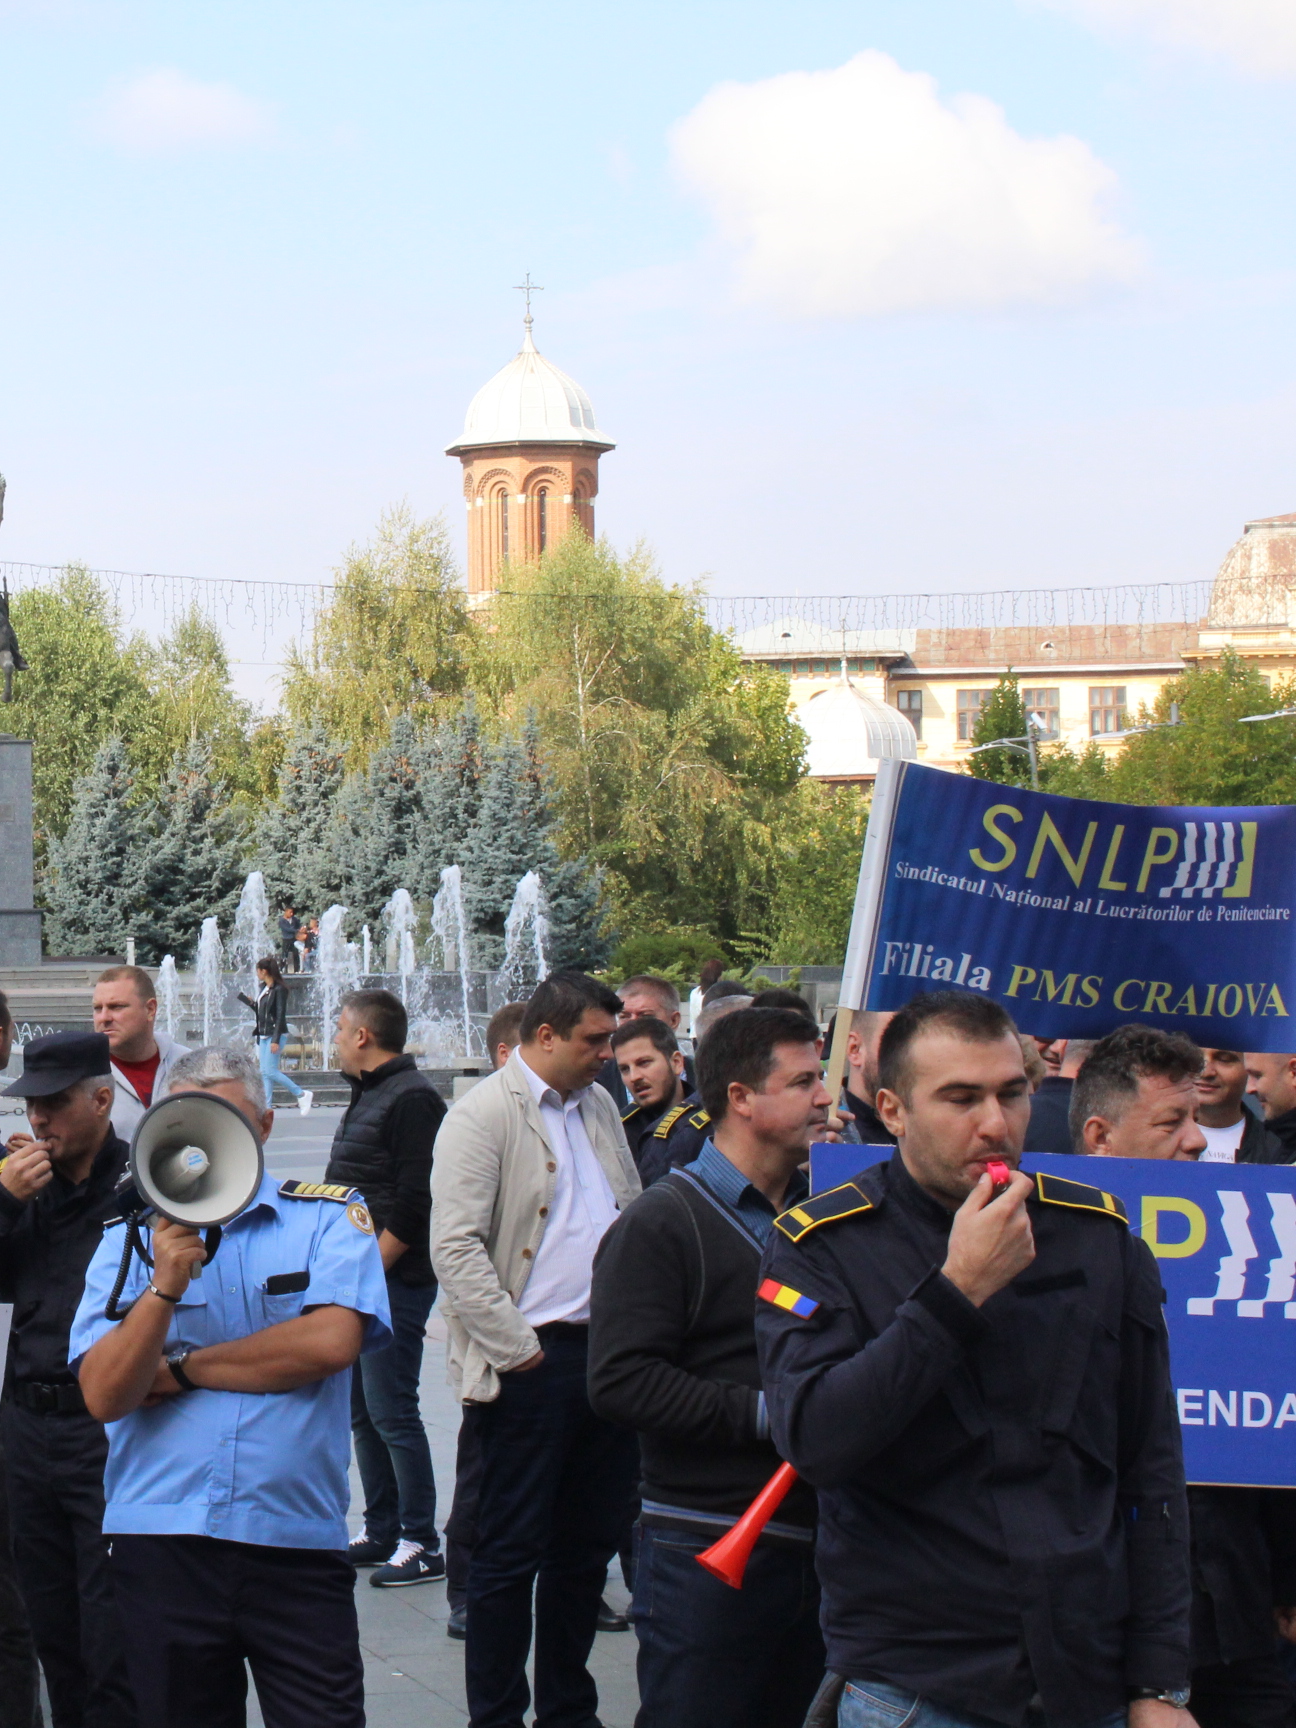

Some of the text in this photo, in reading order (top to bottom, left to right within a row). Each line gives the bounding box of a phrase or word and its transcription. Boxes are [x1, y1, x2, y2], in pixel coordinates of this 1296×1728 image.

[968, 804, 1179, 893] SNLP
[894, 861, 986, 895] Sindicatul
[1072, 898, 1092, 914] al
[1095, 899, 1194, 921] Lucrătorilor
[1197, 905, 1212, 922] de
[1216, 904, 1291, 922] Penitenciare
[878, 941, 1290, 1018] Filiala PMS CRAIOVA
